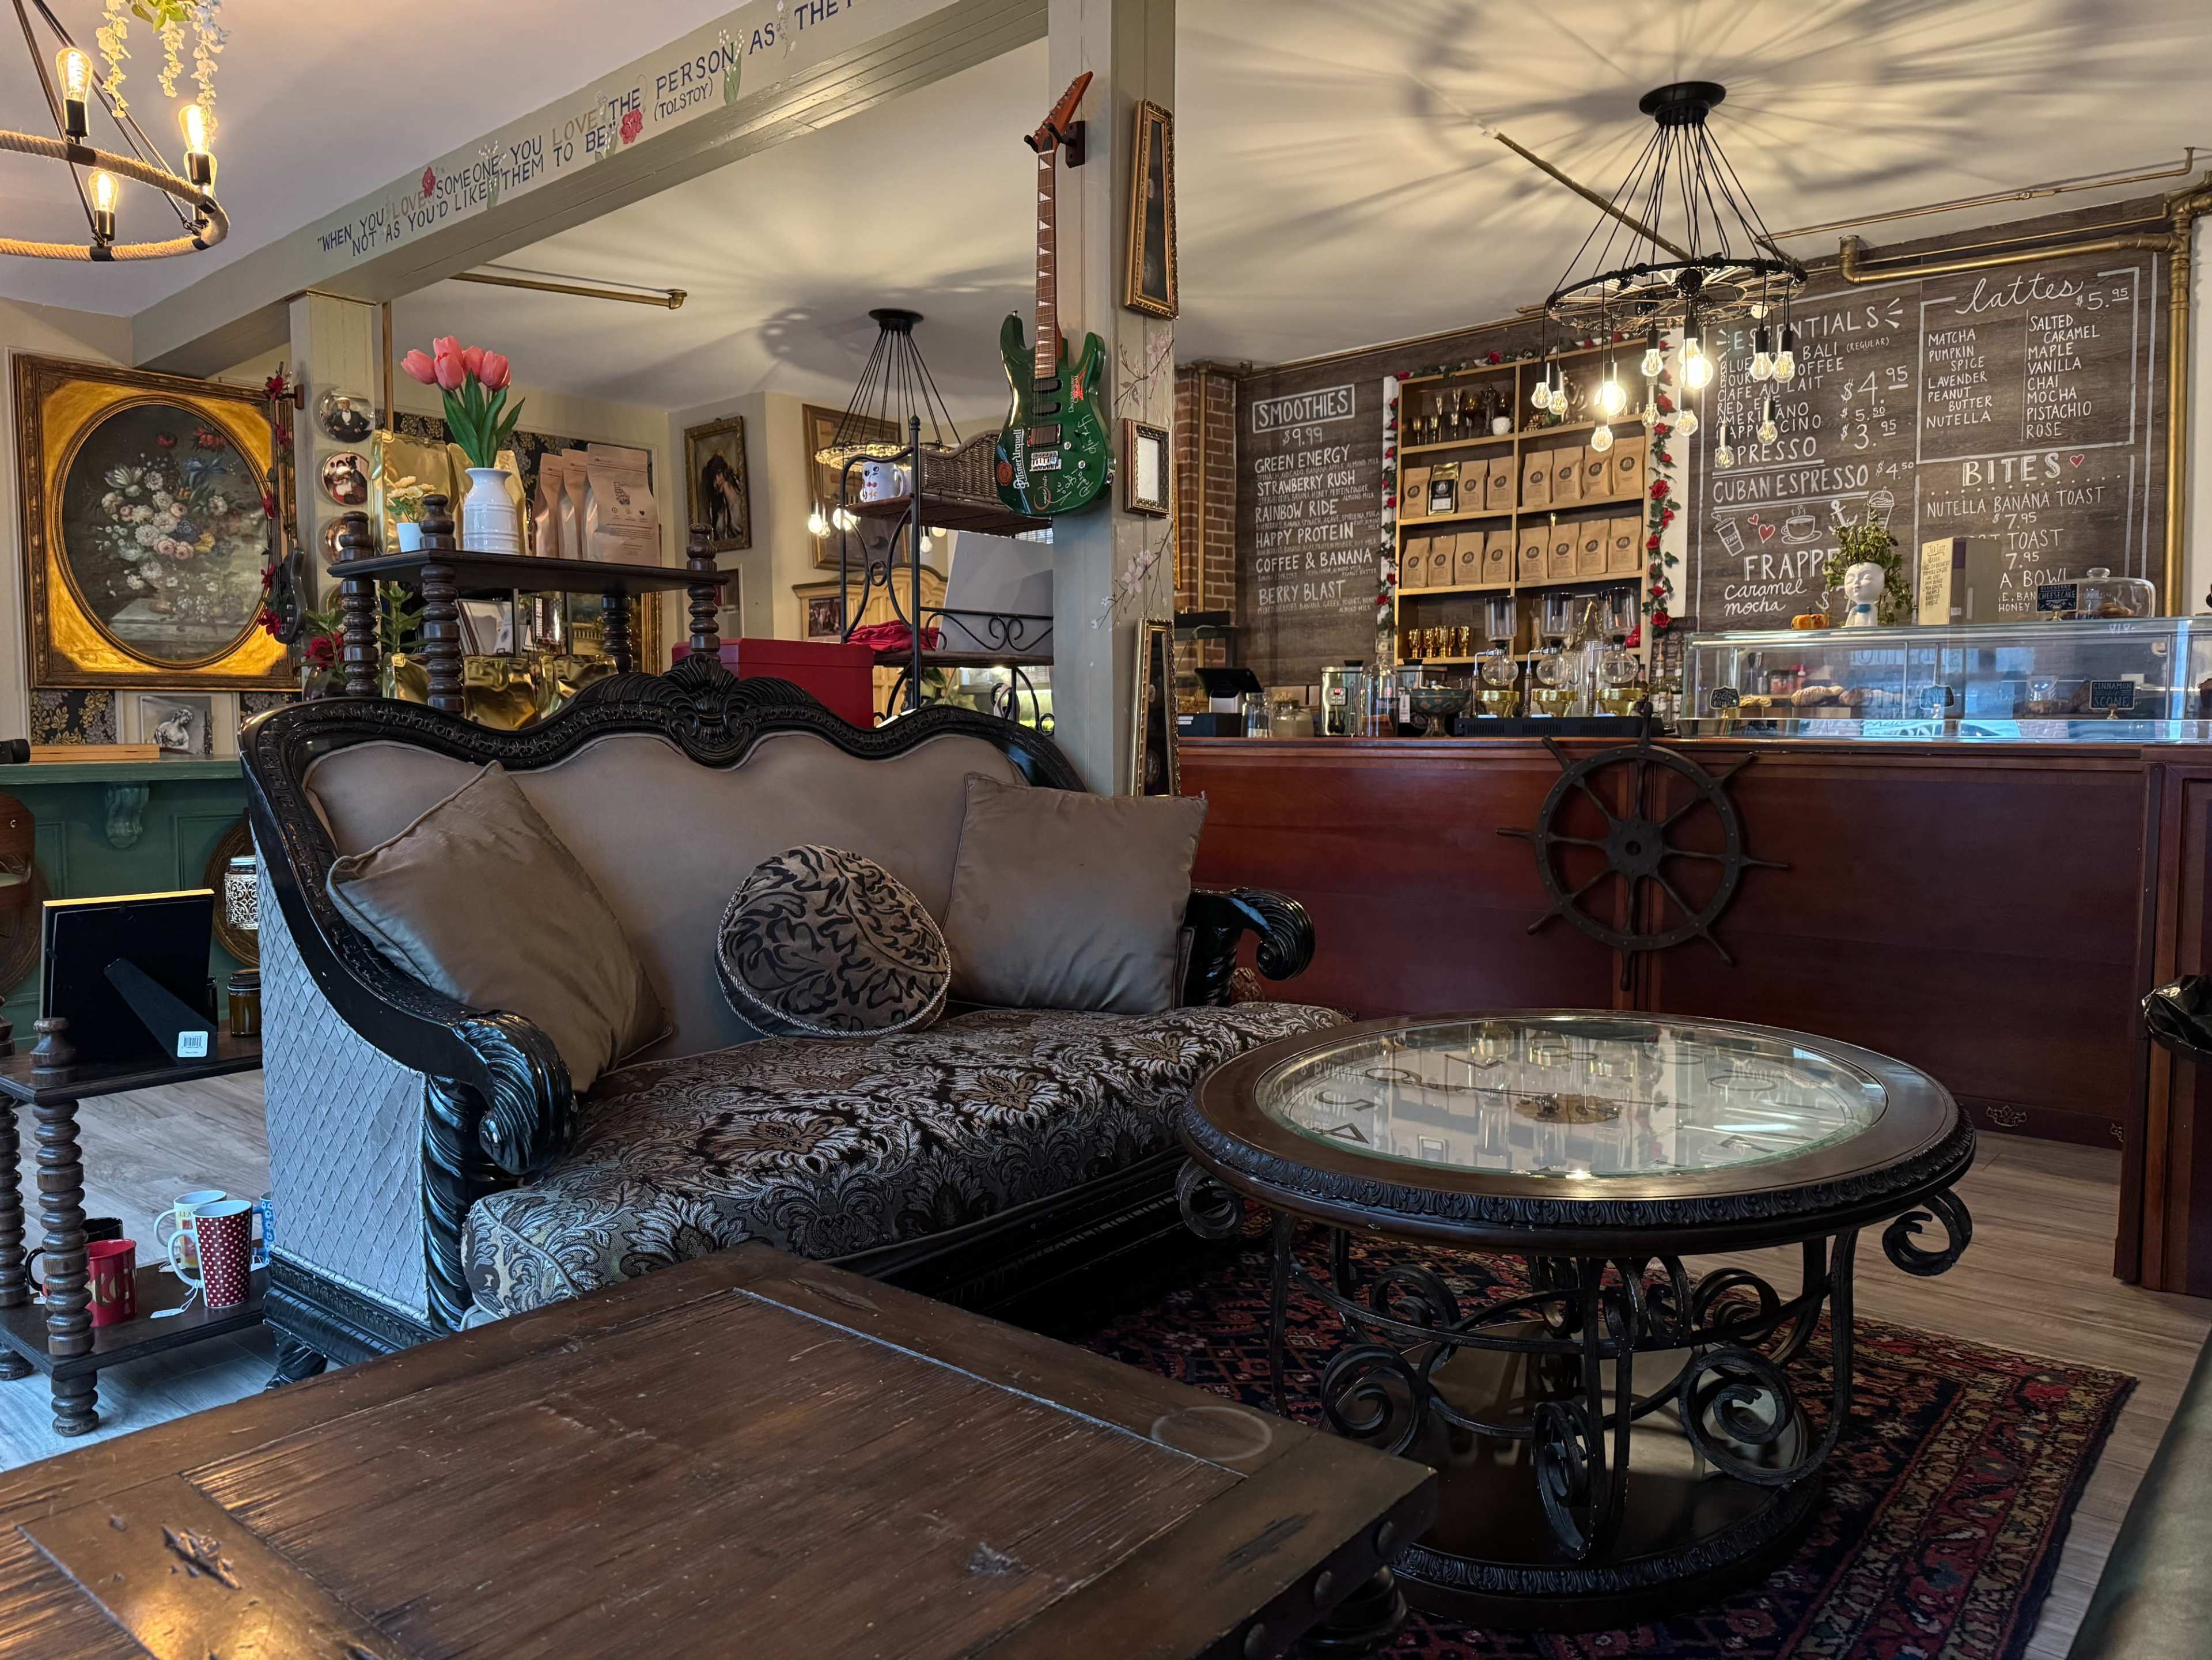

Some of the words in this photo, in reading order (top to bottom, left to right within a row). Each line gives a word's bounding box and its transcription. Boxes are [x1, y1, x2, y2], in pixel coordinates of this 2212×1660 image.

[653, 77, 713, 122] (TOLSTOY)
[359, 208, 384, 235] YOU
[392, 191, 425, 220] LOVE
[510, 135, 543, 165] YOU
[552, 109, 597, 148] LOVE
[608, 88, 641, 120] THE
[656, 41, 735, 100] PERSON
[749, 22, 775, 55] AS
[352, 230, 377, 257] NOT
[385, 221, 400, 243] AS
[407, 201, 448, 232] YOU'D
[454, 181, 487, 212] LIKE
[501, 156, 543, 191] THEM
[553, 142, 573, 167] TO
[1956, 273, 2083, 314] lattes
[1734, 306, 1878, 350] ESENTIALS
[2029, 313, 2073, 332] SALTED
[1929, 328, 1975, 347] MATCHA
[2044, 325, 2100, 343] CARAMEL
[1720, 356, 1752, 375] BLUE
[1802, 342, 1837, 360] BALI
[1846, 337, 1889, 353] (REGULAR)
[1929, 346, 1974, 362] PUMPKIN
[2028, 342, 2074, 360] MAPLE
[1720, 372, 1759, 388] BOUR
[1798, 357, 1844, 376] OFFEE
[1951, 356, 1985, 372] SPICE
[2027, 357, 2082, 375] VANILLA
[1718, 386, 1752, 402] CAFE
[1760, 381, 1779, 396] AU
[1787, 376, 1824, 393] LAIT
[1929, 372, 1987, 389] LAVENDER
[2028, 375, 2058, 391] CHAI
[1717, 400, 1743, 416] RED
[1754, 395, 1781, 410] EE
[1928, 387, 1971, 402] PEANUT
[1949, 395, 1992, 412] BUTTER
[2027, 387, 2077, 404] MOCHA
[1258, 390, 1349, 428] SMOOTHIES
[1715, 402, 1809, 428] AMERIANO
[1926, 410, 1991, 429] NUTELLA
[2027, 401, 2092, 422] PISTACHIO
[1282, 427, 1323, 447] $9.99
[2027, 422, 2062, 439] ROSE
[1255, 453, 1294, 473] GREEN
[1298, 444, 1350, 468] ENERGY
[1715, 436, 1816, 467] PRESSO
[1963, 452, 2061, 487] BITES
[1257, 474, 1323, 497] STRAWBERRY
[1328, 470, 1355, 488] RUSH
[1713, 476, 1770, 503] CUBAN
[1777, 464, 1869, 496] ESPRESSO
[1256, 501, 1303, 523] RAINBOW
[1309, 499, 1339, 517] RIDE
[1927, 497, 1986, 518] NUTELLA
[1994, 491, 2050, 513] BANANA
[2056, 486, 2105, 506] TOAST
[1256, 528, 1292, 549] HAPPY
[1298, 521, 1354, 544] PROTEIN
[2008, 528, 2065, 551] TOAST
[1256, 554, 1300, 573] COFFEE
[1305, 552, 1315, 570] &
[1320, 548, 1372, 567] BANANA
[1259, 585, 1298, 606] BERRY
[1304, 579, 1346, 602] BLAST
[1725, 578, 1806, 600] caramel
[2039, 591, 2075, 600] CHEESECAKE
[1725, 597, 1786, 617] mocha
[1998, 603, 2031, 612] HONEY
[2094, 696, 2129, 706] SCONE
